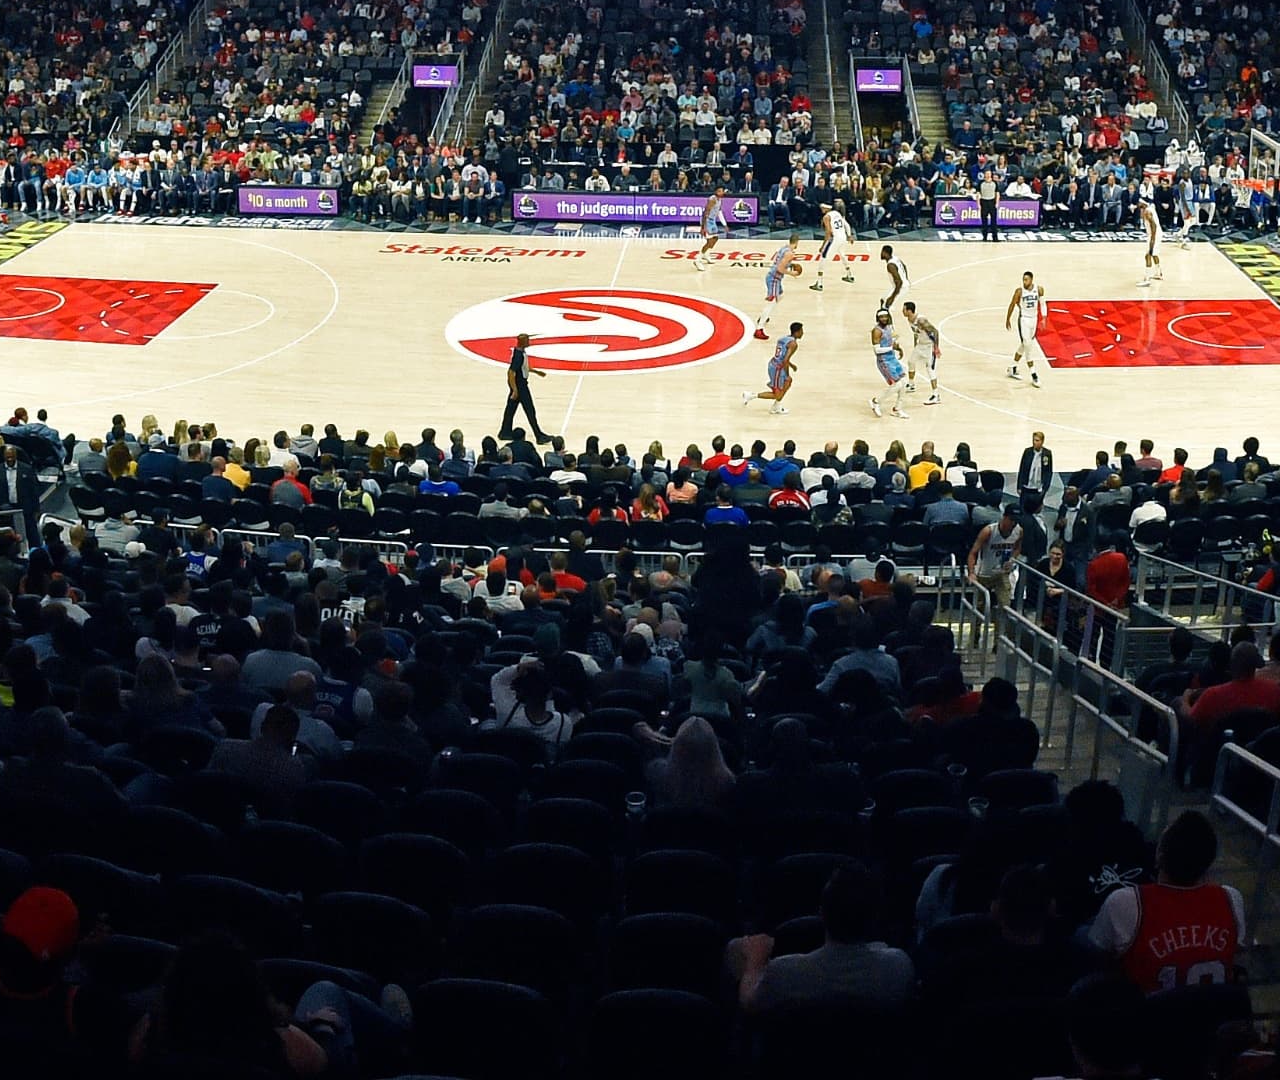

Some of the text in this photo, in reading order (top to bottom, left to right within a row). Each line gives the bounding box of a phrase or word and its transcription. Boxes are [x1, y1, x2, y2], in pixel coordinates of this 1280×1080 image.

[248, 192, 308, 209] $10 a month
[556, 201, 677, 218] the judgement free
[998, 207, 1034, 220] fitness
[379, 244, 587, 258] State Farm
[440, 255, 512, 263] ARENA
[1149, 924, 1230, 959] CHEEKS
